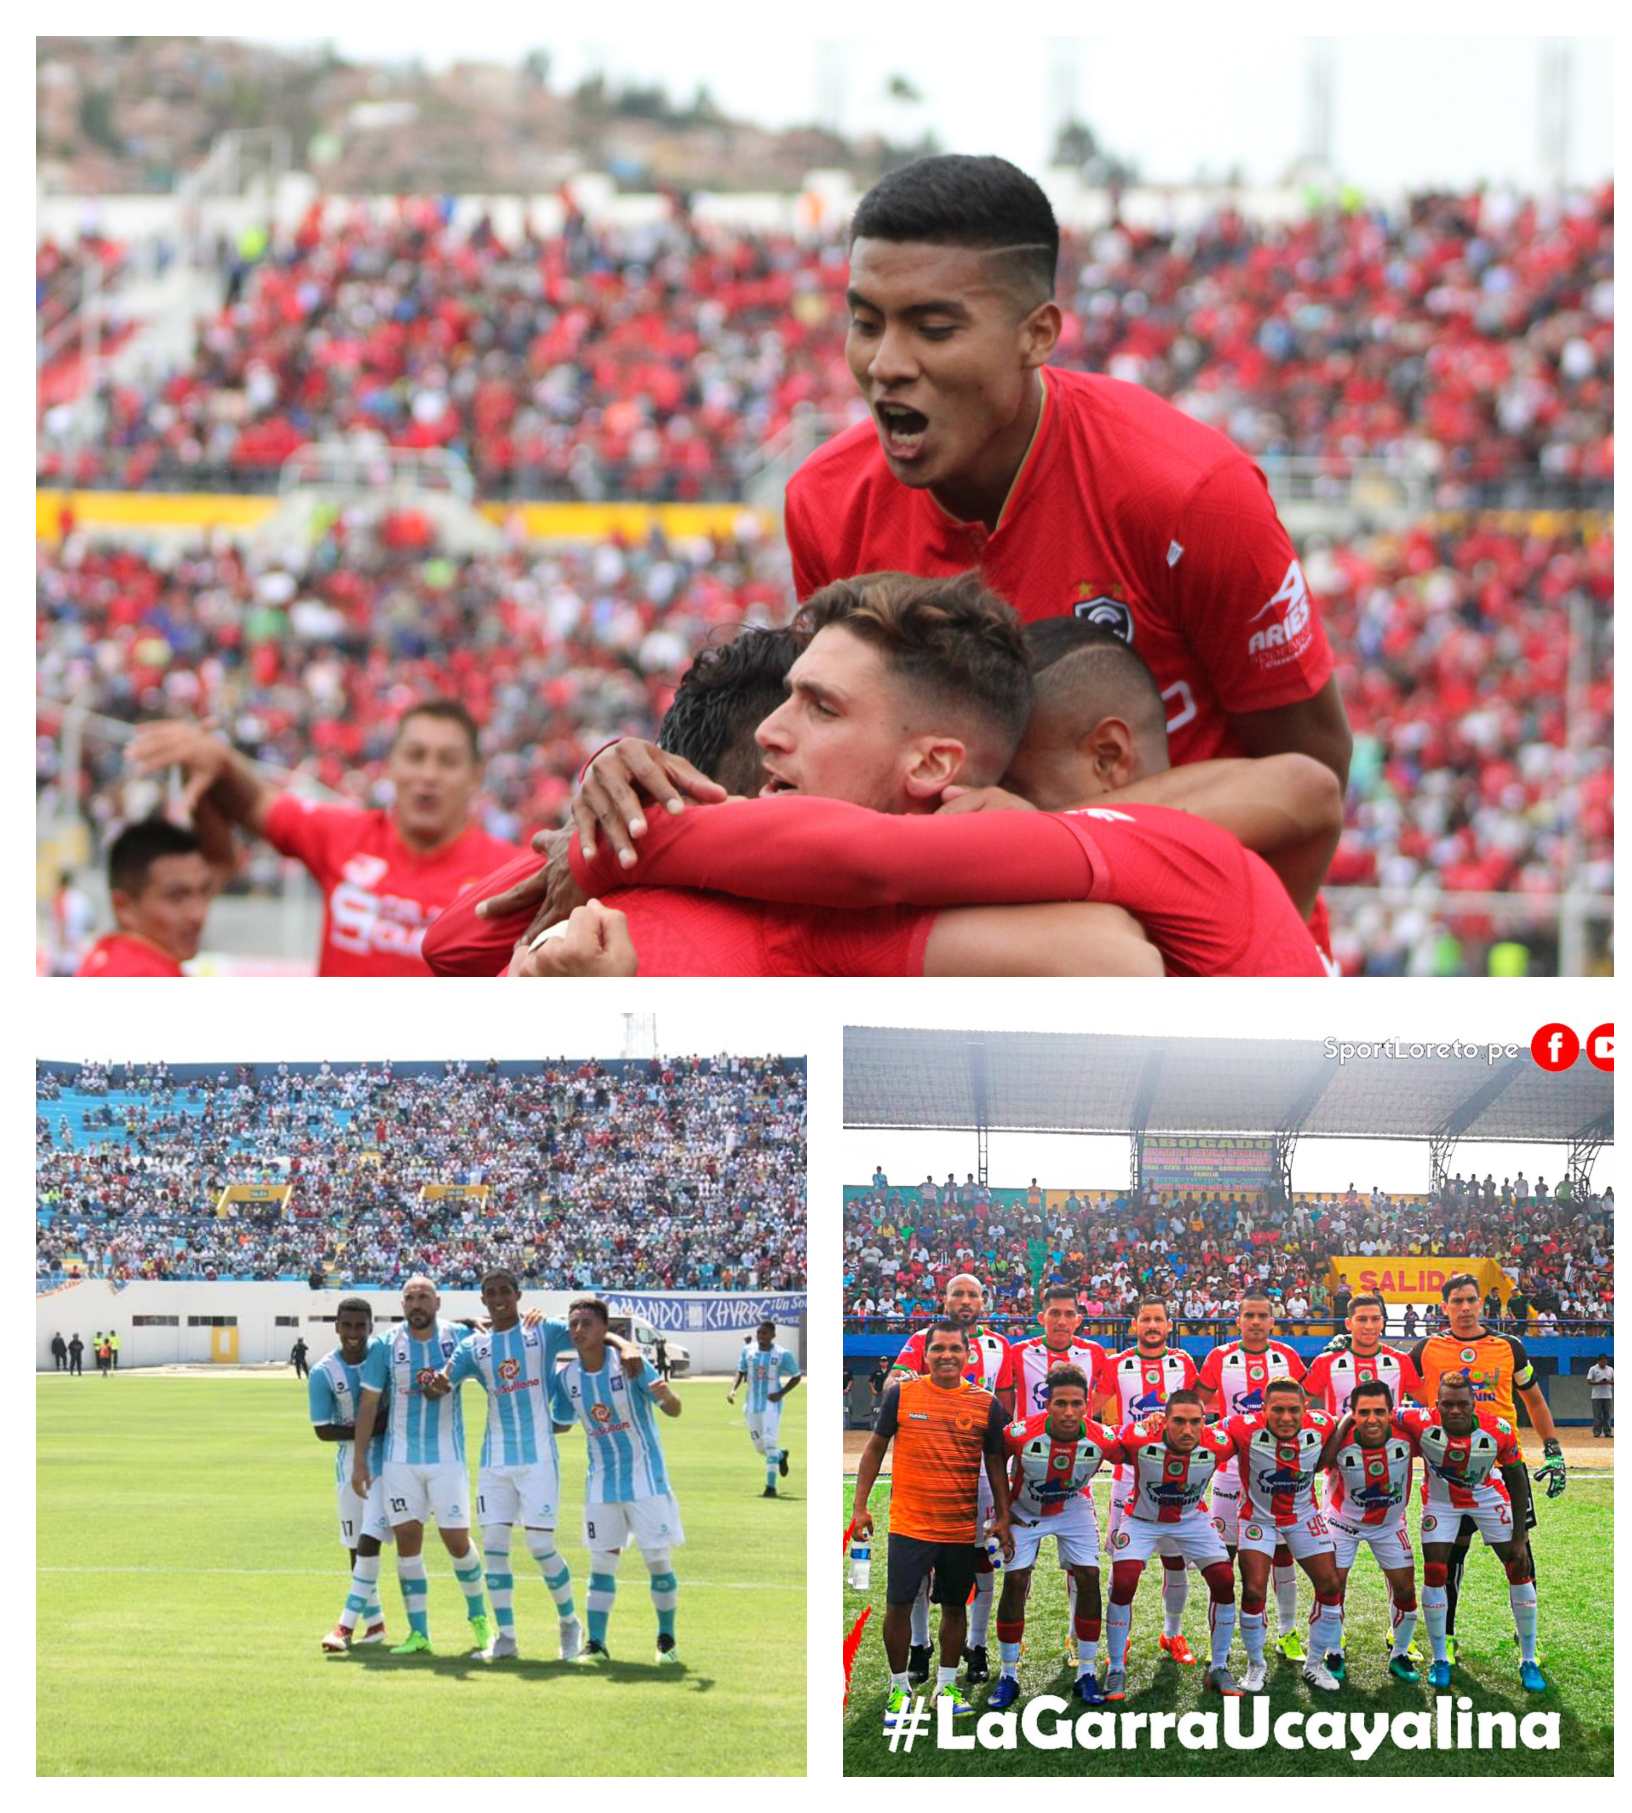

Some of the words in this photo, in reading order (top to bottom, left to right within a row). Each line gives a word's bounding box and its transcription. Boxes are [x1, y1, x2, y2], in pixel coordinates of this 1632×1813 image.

[1249, 600, 1309, 654] ARIES
[1360, 1270, 1459, 1292] SALID
[601, 1295, 683, 1329] MANDO
[1495, 1505, 1510, 1525] 2
[587, 1522, 596, 1539] 8
